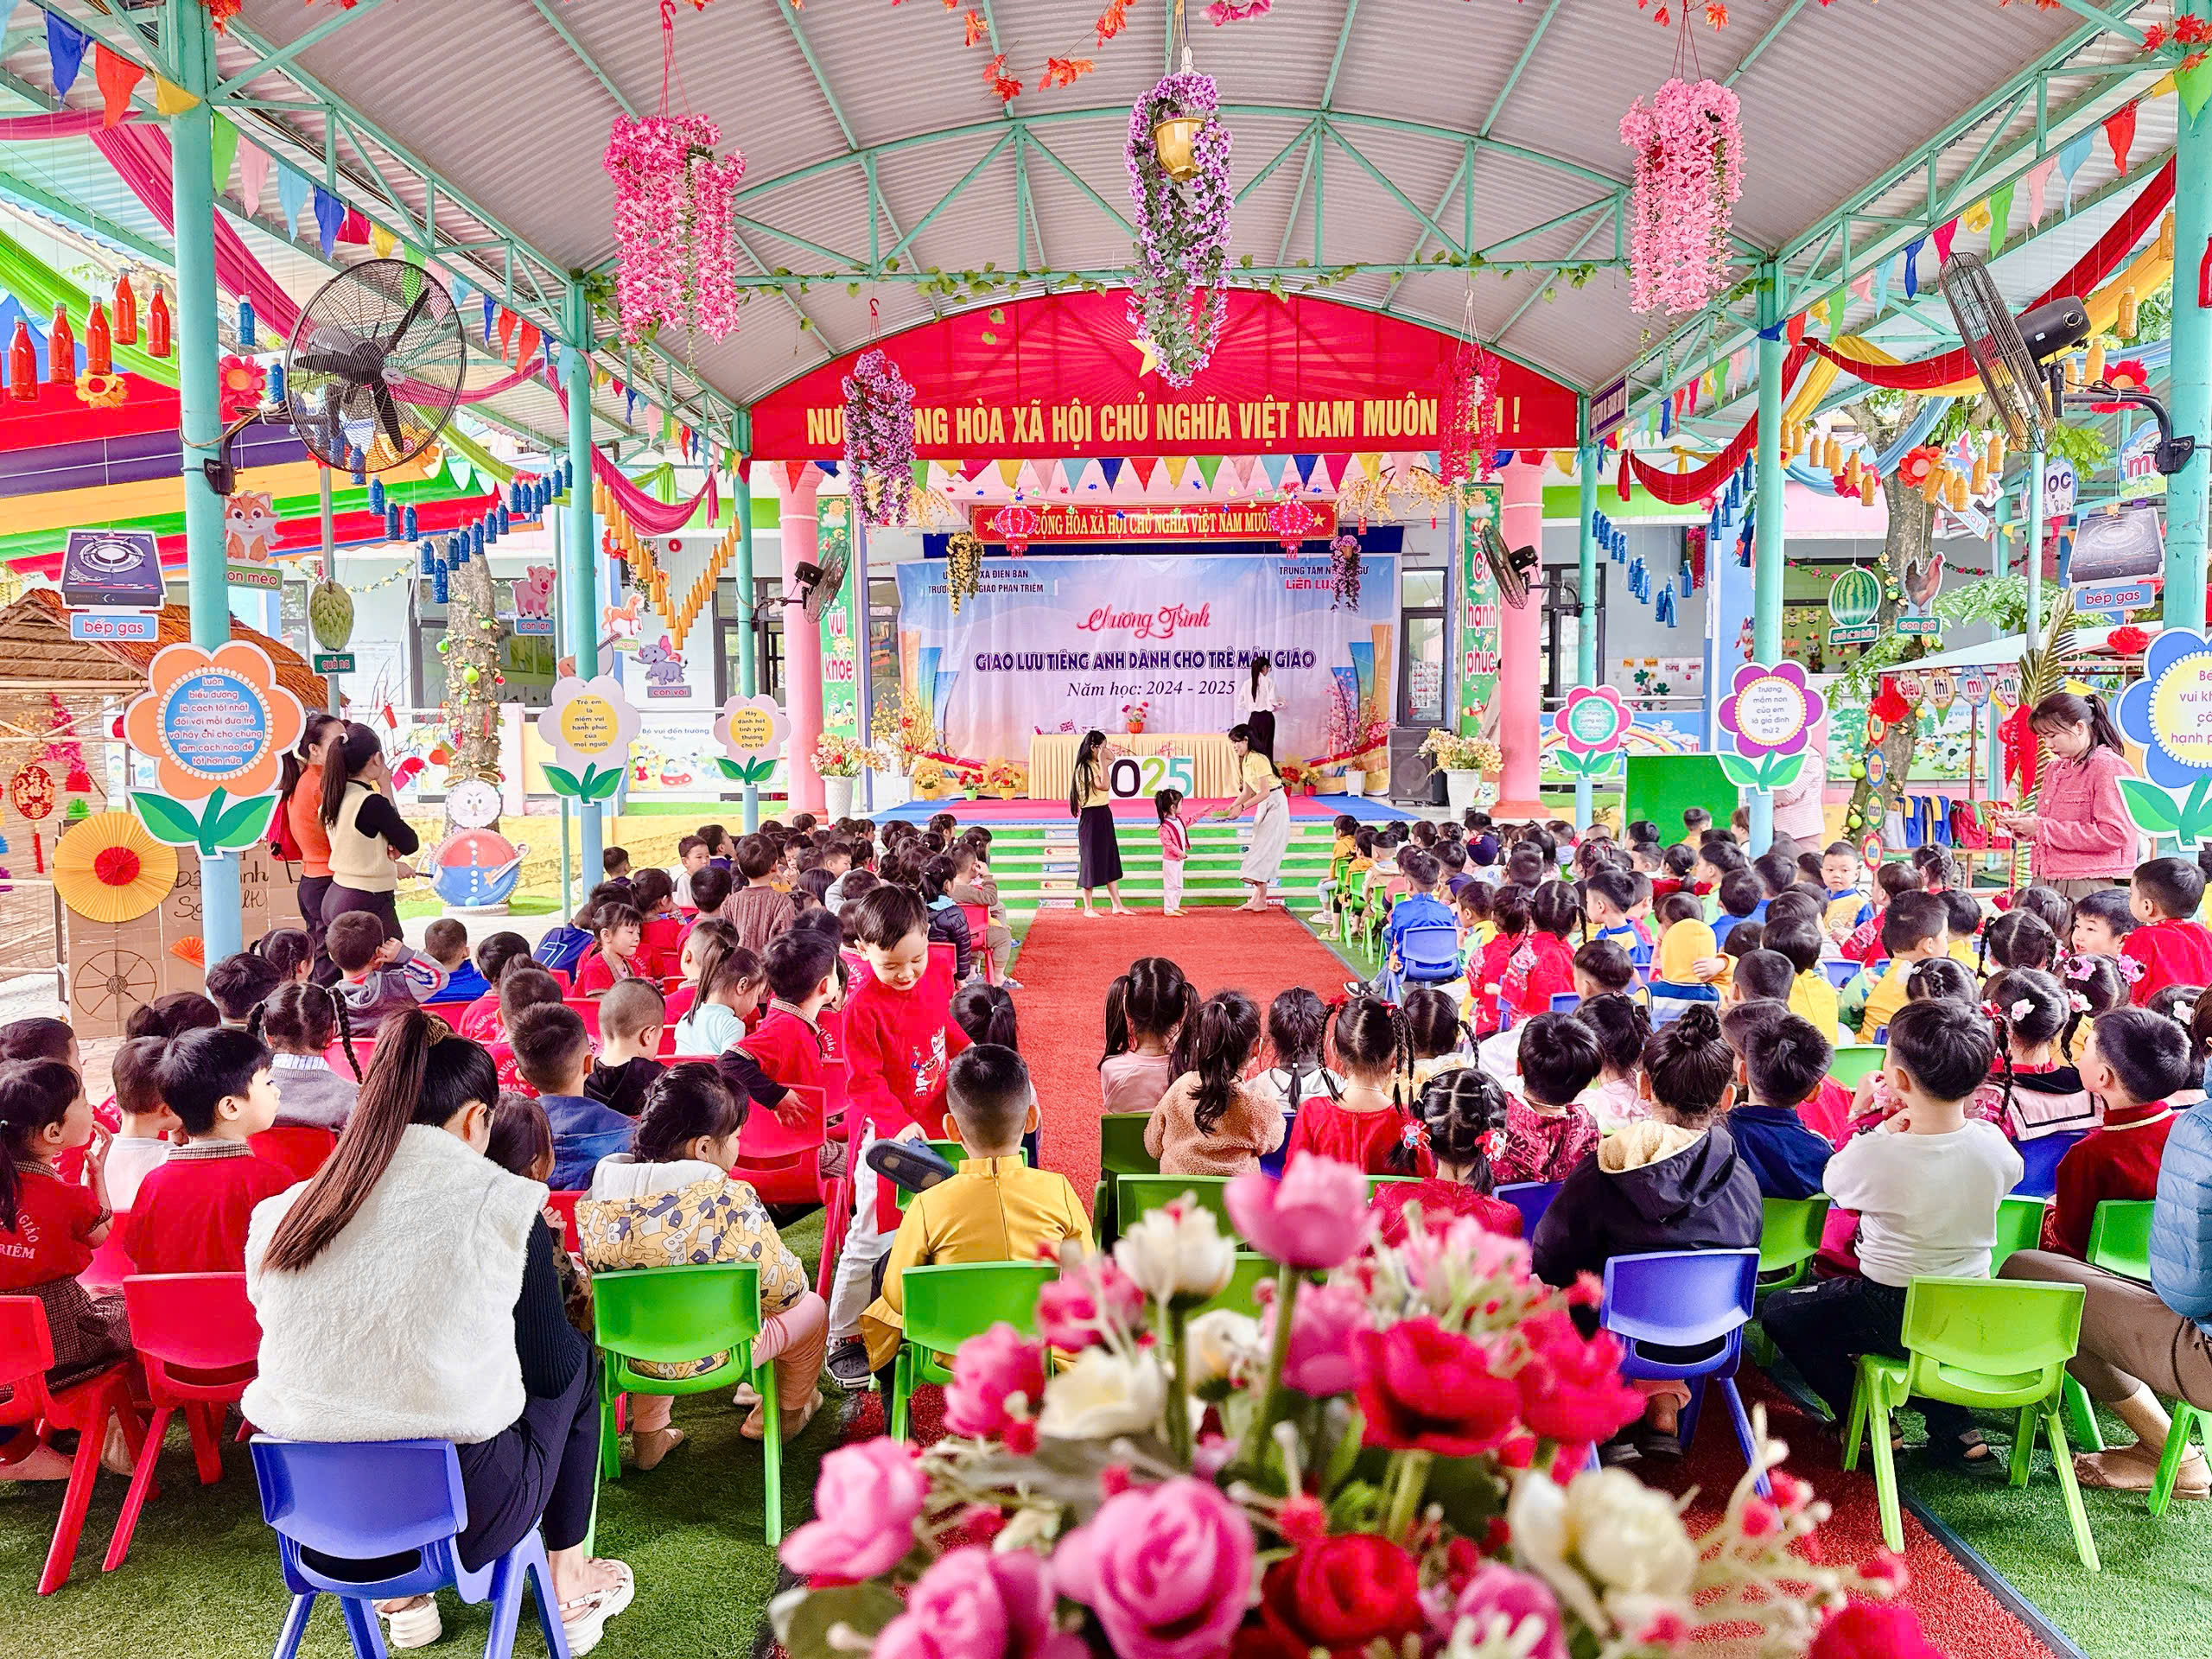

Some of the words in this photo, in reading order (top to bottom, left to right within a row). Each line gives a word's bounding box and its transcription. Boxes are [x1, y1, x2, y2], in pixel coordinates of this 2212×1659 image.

[956, 397, 1003, 444] HÒA
[1012, 399, 1045, 443] XÃ
[1052, 397, 1092, 451] HỘI
[1100, 391, 1148, 443] CHỦ
[1156, 395, 1231, 441] NGHĨA
[1238, 394, 1291, 448] VIỆT
[1297, 400, 1355, 439] NAM
[1363, 391, 1438, 437] MUÔN
[1192, 508, 1217, 537] VIỆT
[1219, 512, 1243, 533] NAM
[228, 572, 244, 582] on
[246, 569, 277, 585] mèo
[1279, 566, 1305, 575] TRUNG
[2086, 591, 2112, 605] bếp
[2116, 591, 2140, 603] gas
[83, 616, 113, 636] bếp
[118, 622, 144, 636] gas
[829, 607, 847, 637] vui
[1076, 603, 1159, 639] Chương
[1158, 602, 1211, 633] Trình
[1466, 599, 1496, 637] hạnh
[1922, 620, 1936, 632] gà
[975, 652, 1014, 671] GIAO
[1016, 652, 1045, 671] LƯU
[1046, 649, 1090, 671] TIẾNG
[1092, 652, 1126, 671] ANH
[1128, 649, 1171, 670] DÀNH
[1173, 650, 1206, 669] CHO
[1207, 645, 1236, 669] TRẺ
[1274, 647, 1317, 670] GIÁO
[1465, 643, 1497, 680] phúc
[1067, 683, 1104, 696] Năm
[1110, 682, 1142, 698] học:
[1146, 681, 1183, 695] 2024
[1198, 680, 1236, 695] 2025
[1901, 680, 1919, 696] Siêu
[1935, 678, 1948, 699] thị
[1967, 677, 1983, 693] mi
[2179, 691, 2197, 702] vui
[2171, 733, 2203, 747] hạnh
[18, 1214, 41, 1243] GIÁO
